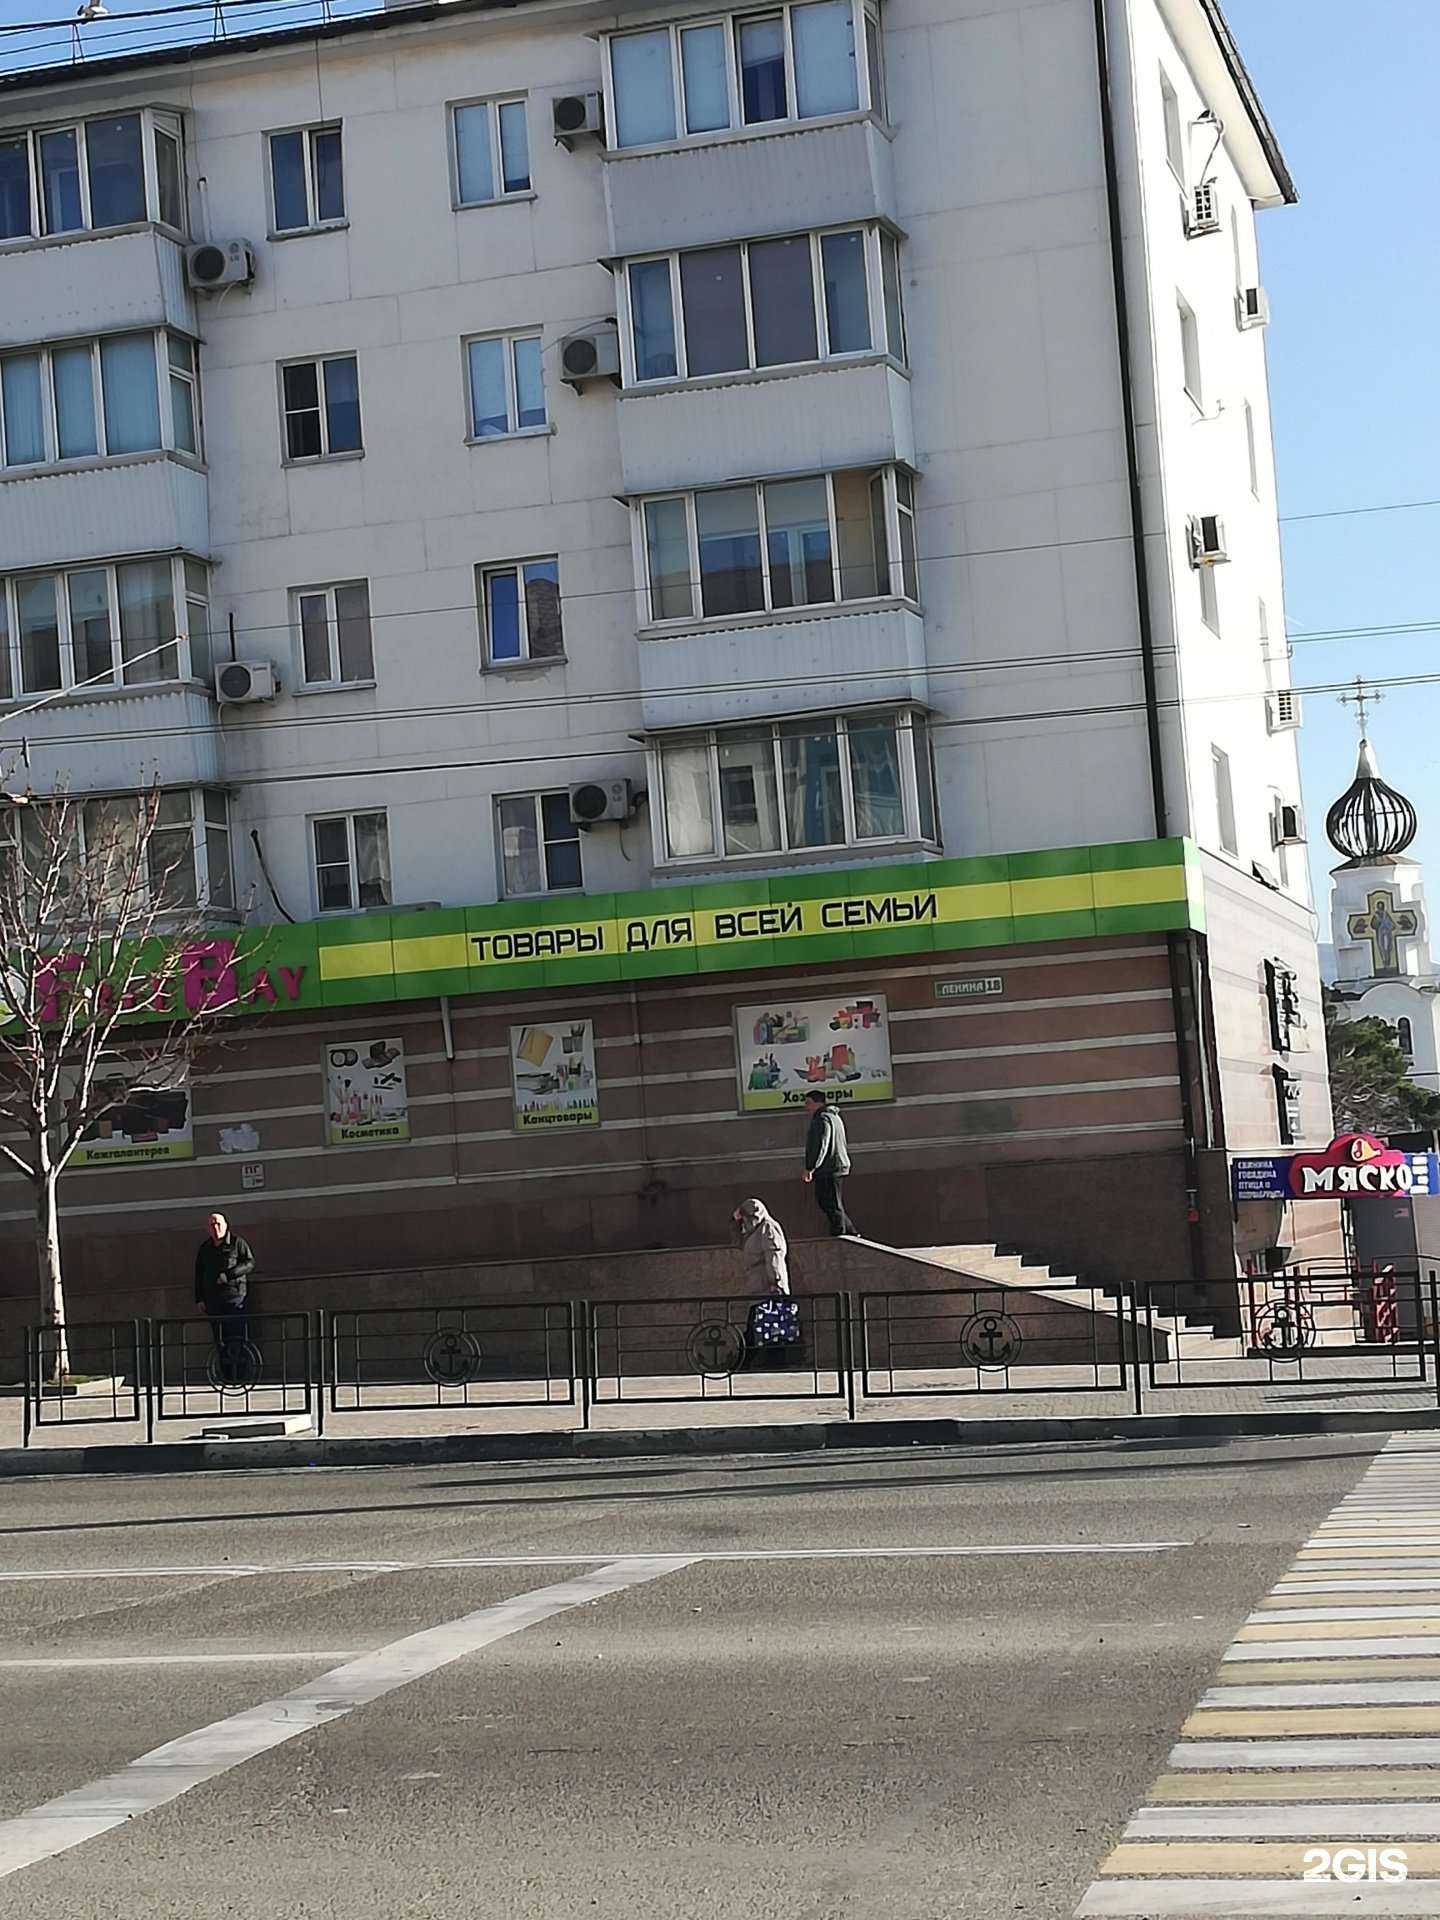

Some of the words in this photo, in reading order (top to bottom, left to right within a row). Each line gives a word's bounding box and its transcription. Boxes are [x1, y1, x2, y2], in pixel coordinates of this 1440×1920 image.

[471, 926, 604, 961] ТОВАРЫ
[626, 917, 693, 952] ДЛЯ
[714, 902, 803, 939] ВСЕЙ
[821, 894, 938, 928] СЕМЬИ
[942, 981, 984, 995] ЛЕНИНА
[782, 1088, 853, 1104] Хозары
[523, 1110, 593, 1125] Канцтовары
[341, 1126, 400, 1139] Косметика
[87, 1145, 170, 1161] Кожгалантерея
[1302, 1164, 1413, 1193] МЯСКО
